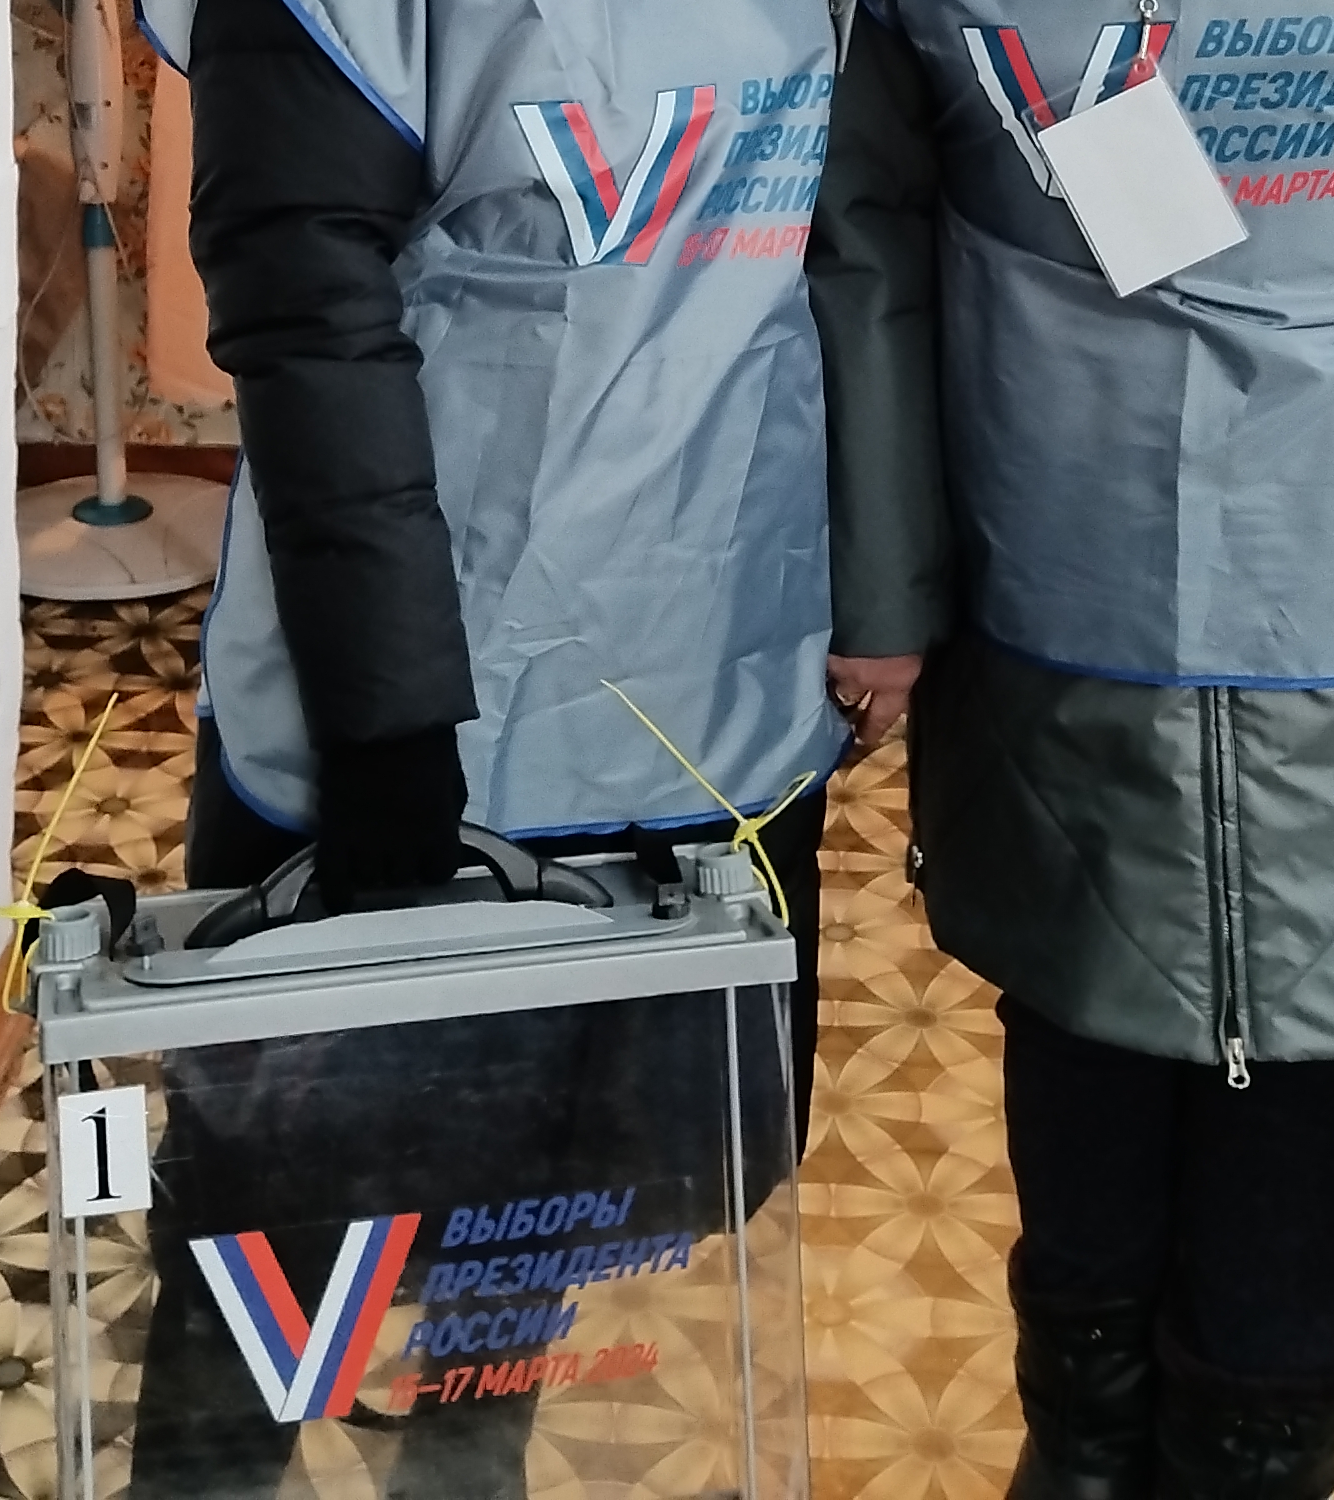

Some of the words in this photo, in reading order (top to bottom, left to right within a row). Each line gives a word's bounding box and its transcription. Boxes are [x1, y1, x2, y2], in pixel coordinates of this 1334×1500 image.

[728, 223, 812, 261] МАРТ
[80, 1106, 122, 1202] 1
[440, 1185, 637, 1248] ВЫБОРЫ
[418, 1231, 693, 1307] ПРЕЗИДЕНТА
[399, 1301, 579, 1362] РОССИИ
[474, 1351, 582, 1400] МАРТА
